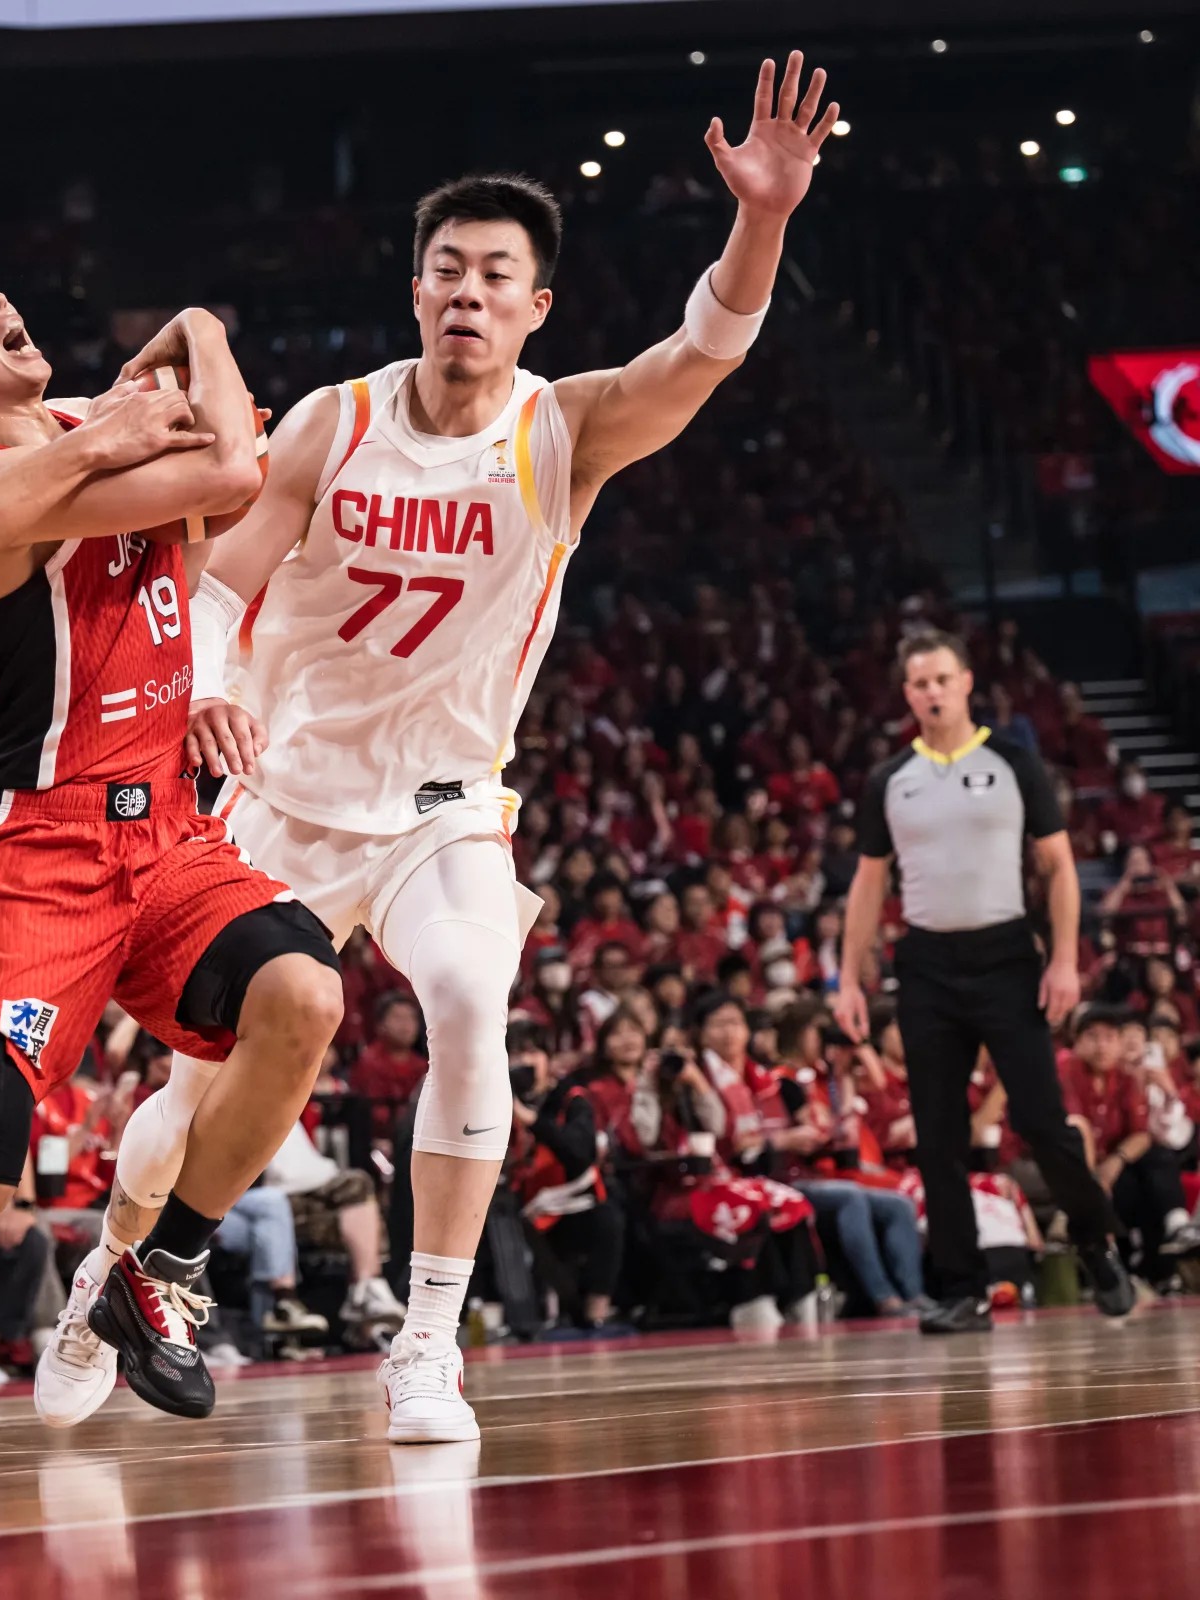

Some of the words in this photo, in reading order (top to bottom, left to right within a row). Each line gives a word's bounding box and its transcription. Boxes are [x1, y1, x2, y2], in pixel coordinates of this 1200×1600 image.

[332, 489, 494, 555] CHINA
[137, 575, 181, 646] 19
[338, 566, 465, 659] 77
